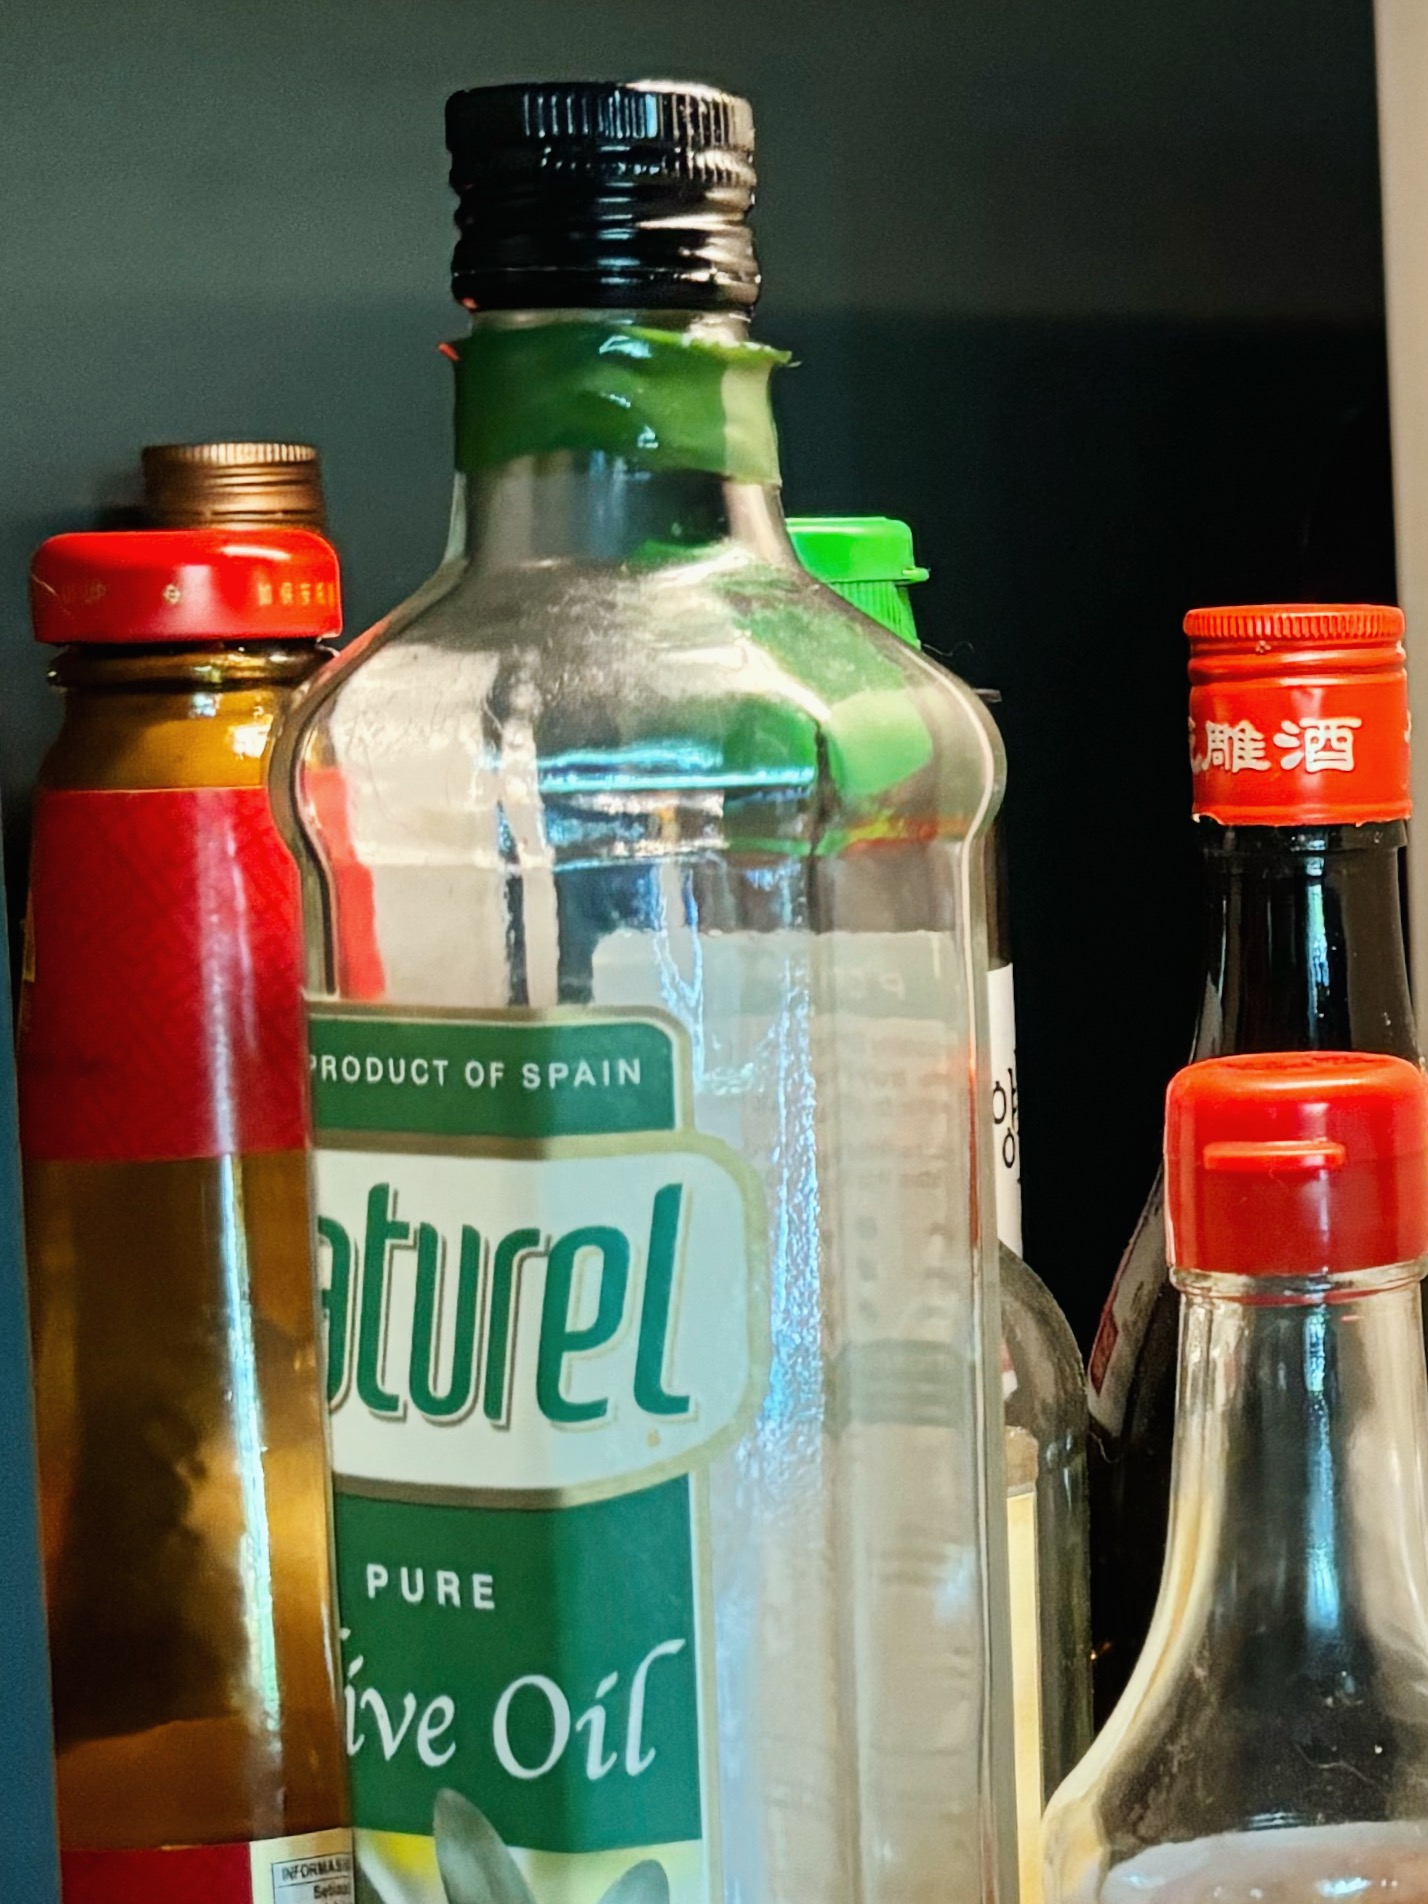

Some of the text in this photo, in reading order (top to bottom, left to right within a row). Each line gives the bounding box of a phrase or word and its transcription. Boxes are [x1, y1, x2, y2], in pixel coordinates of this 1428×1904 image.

[464, 1059, 505, 1089] OF
[521, 1058, 642, 1091] SPAIN
[317, 1182, 692, 1428] aturel
[366, 1563, 495, 1610] PURE
[343, 1638, 686, 1781] ive Oil
